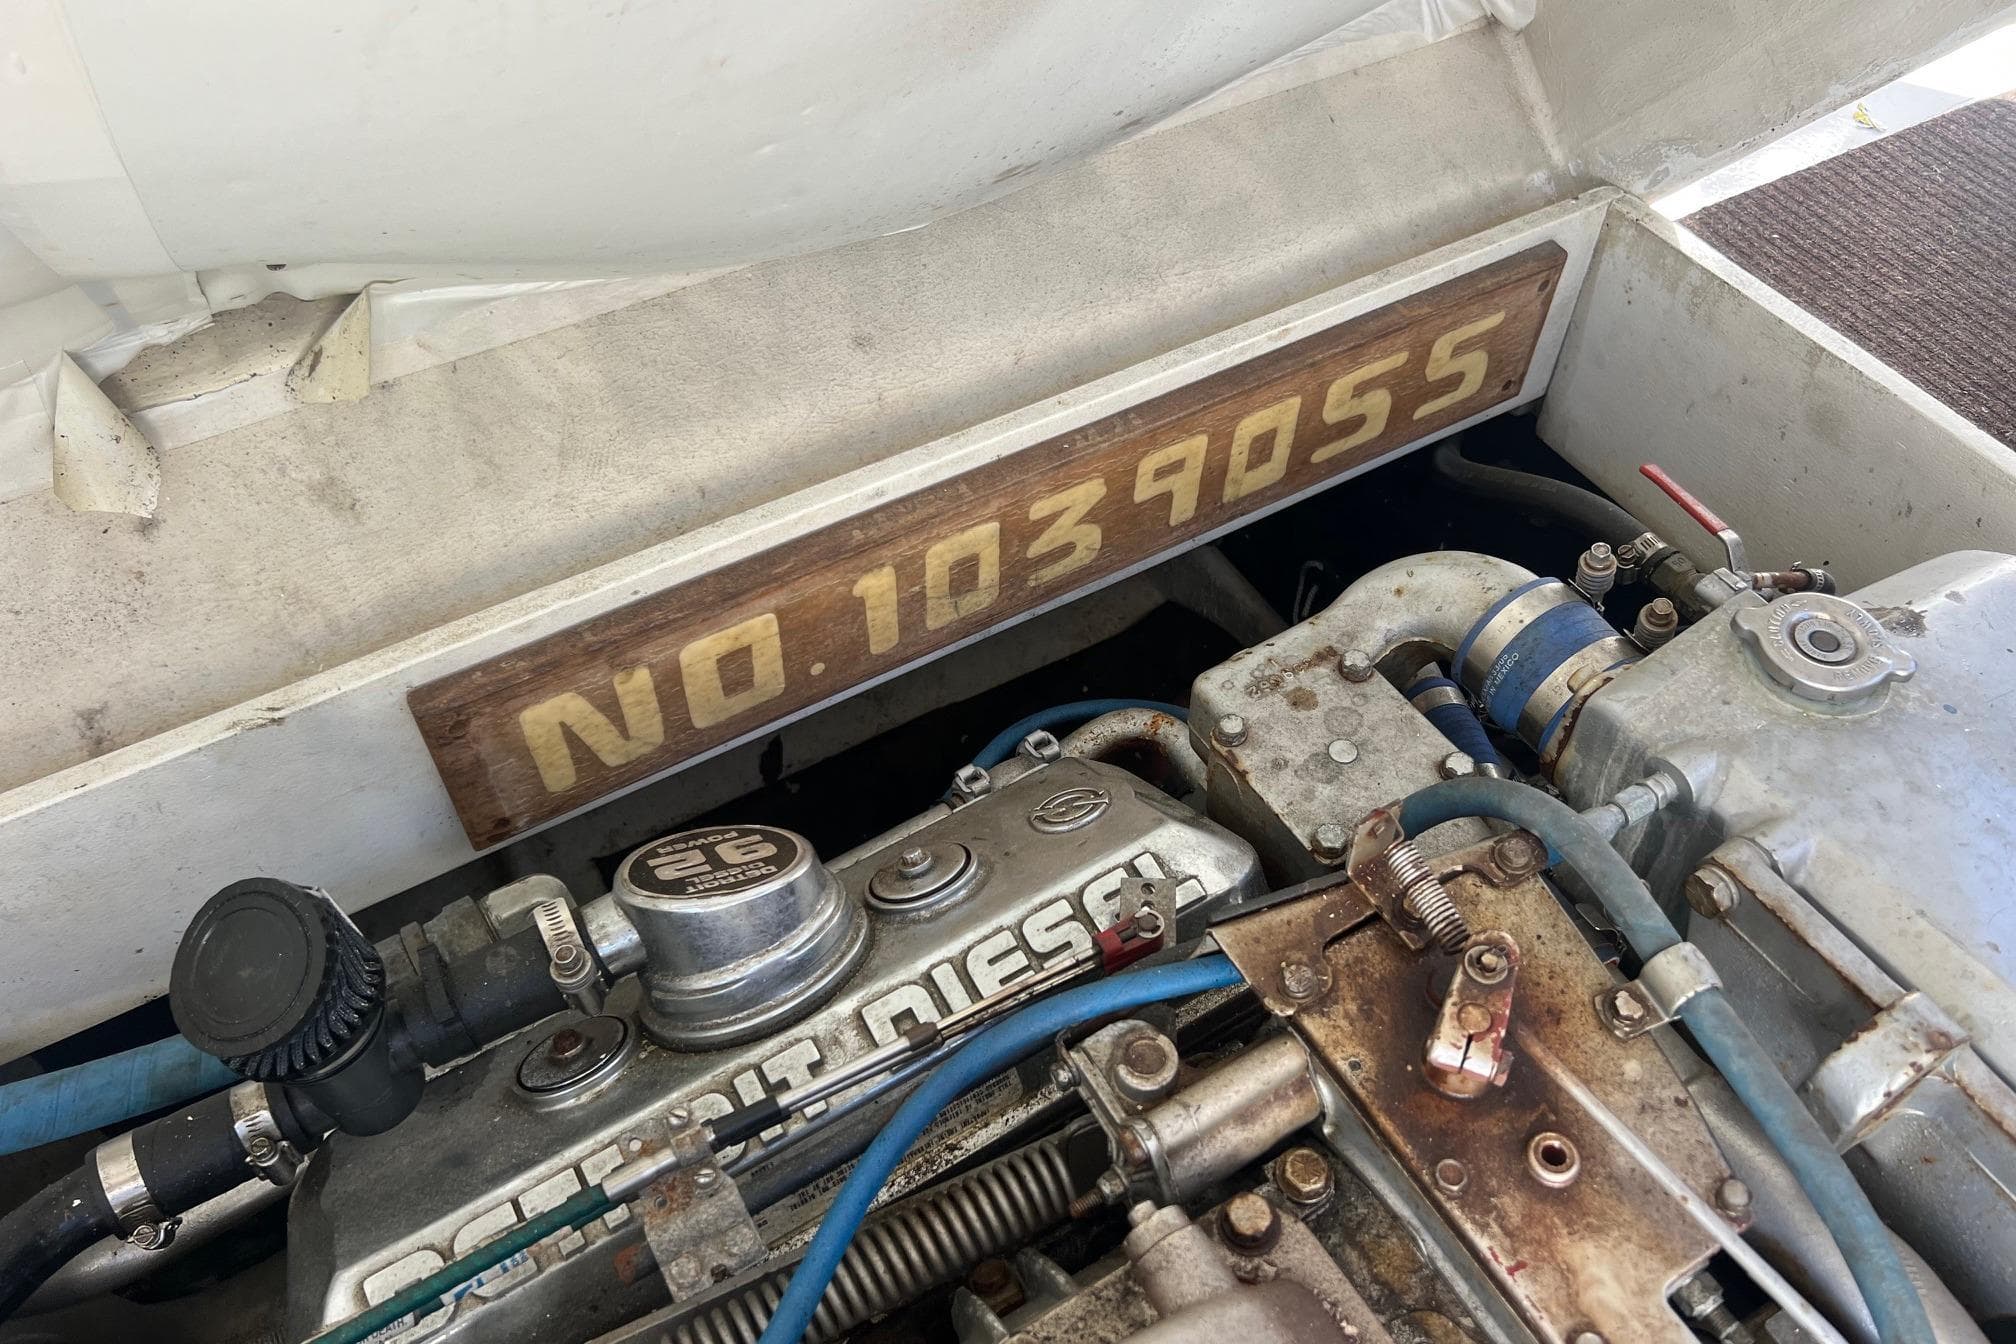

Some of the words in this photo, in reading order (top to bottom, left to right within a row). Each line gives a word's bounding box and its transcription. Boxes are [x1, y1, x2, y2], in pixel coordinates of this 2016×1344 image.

[518, 612, 826, 793] NO.
[852, 312, 1506, 656] 1039055
[1494, 652, 1519, 685] MEXICO
[646, 834, 778, 881] 92
[656, 830, 739, 854] POWER
[685, 861, 766, 883] DIESEL
[685, 865, 778, 894] DETROIT
